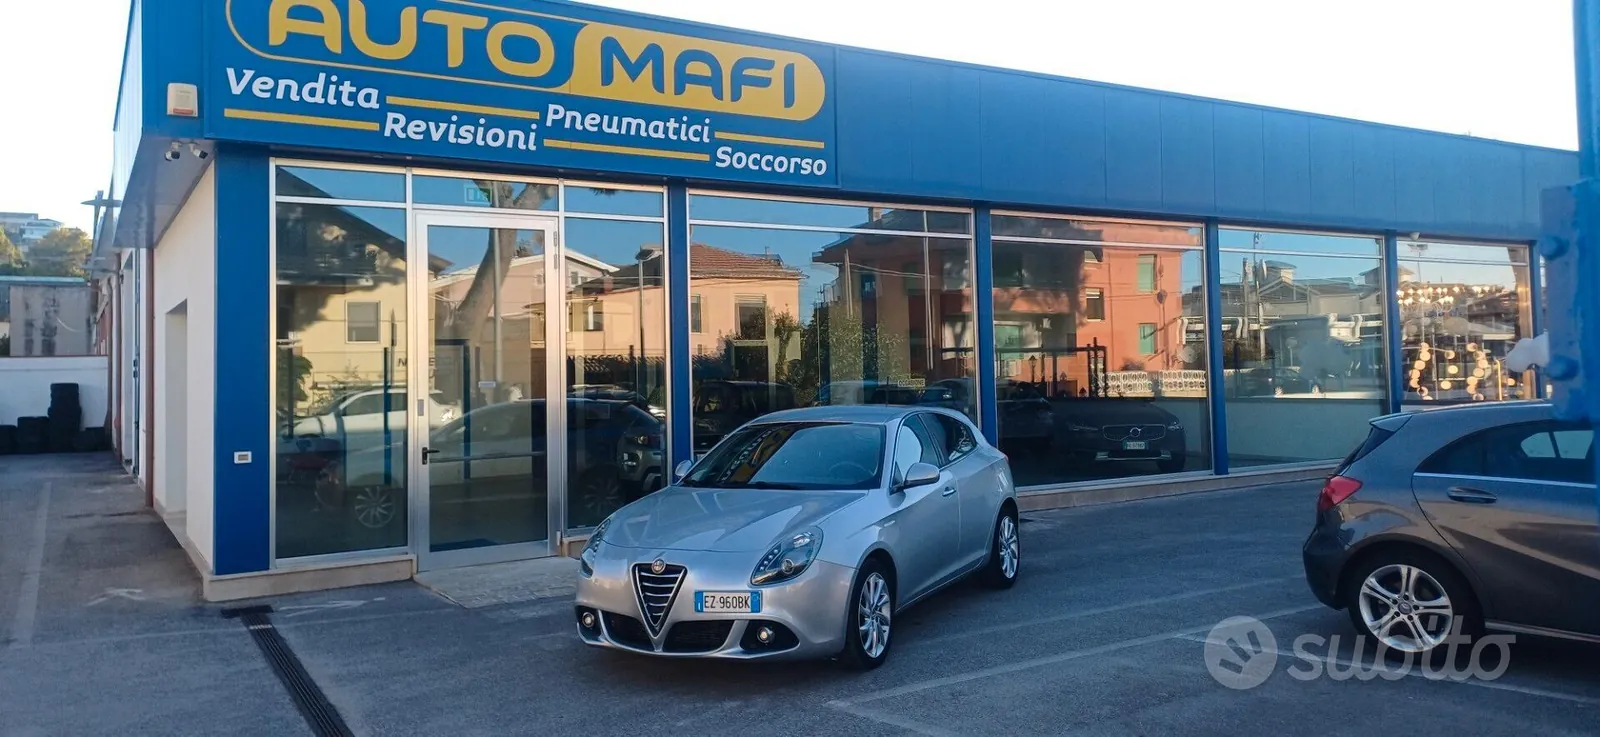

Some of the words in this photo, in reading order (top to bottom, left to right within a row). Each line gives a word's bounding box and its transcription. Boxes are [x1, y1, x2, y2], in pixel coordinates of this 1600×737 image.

[269, 0, 554, 77] AUTO
[601, 36, 795, 108] MAFI
[226, 67, 380, 109] Vendita
[383, 112, 537, 150] Revisioni
[546, 104, 710, 142] Pneumatici
[715, 146, 827, 175] Soccorso
